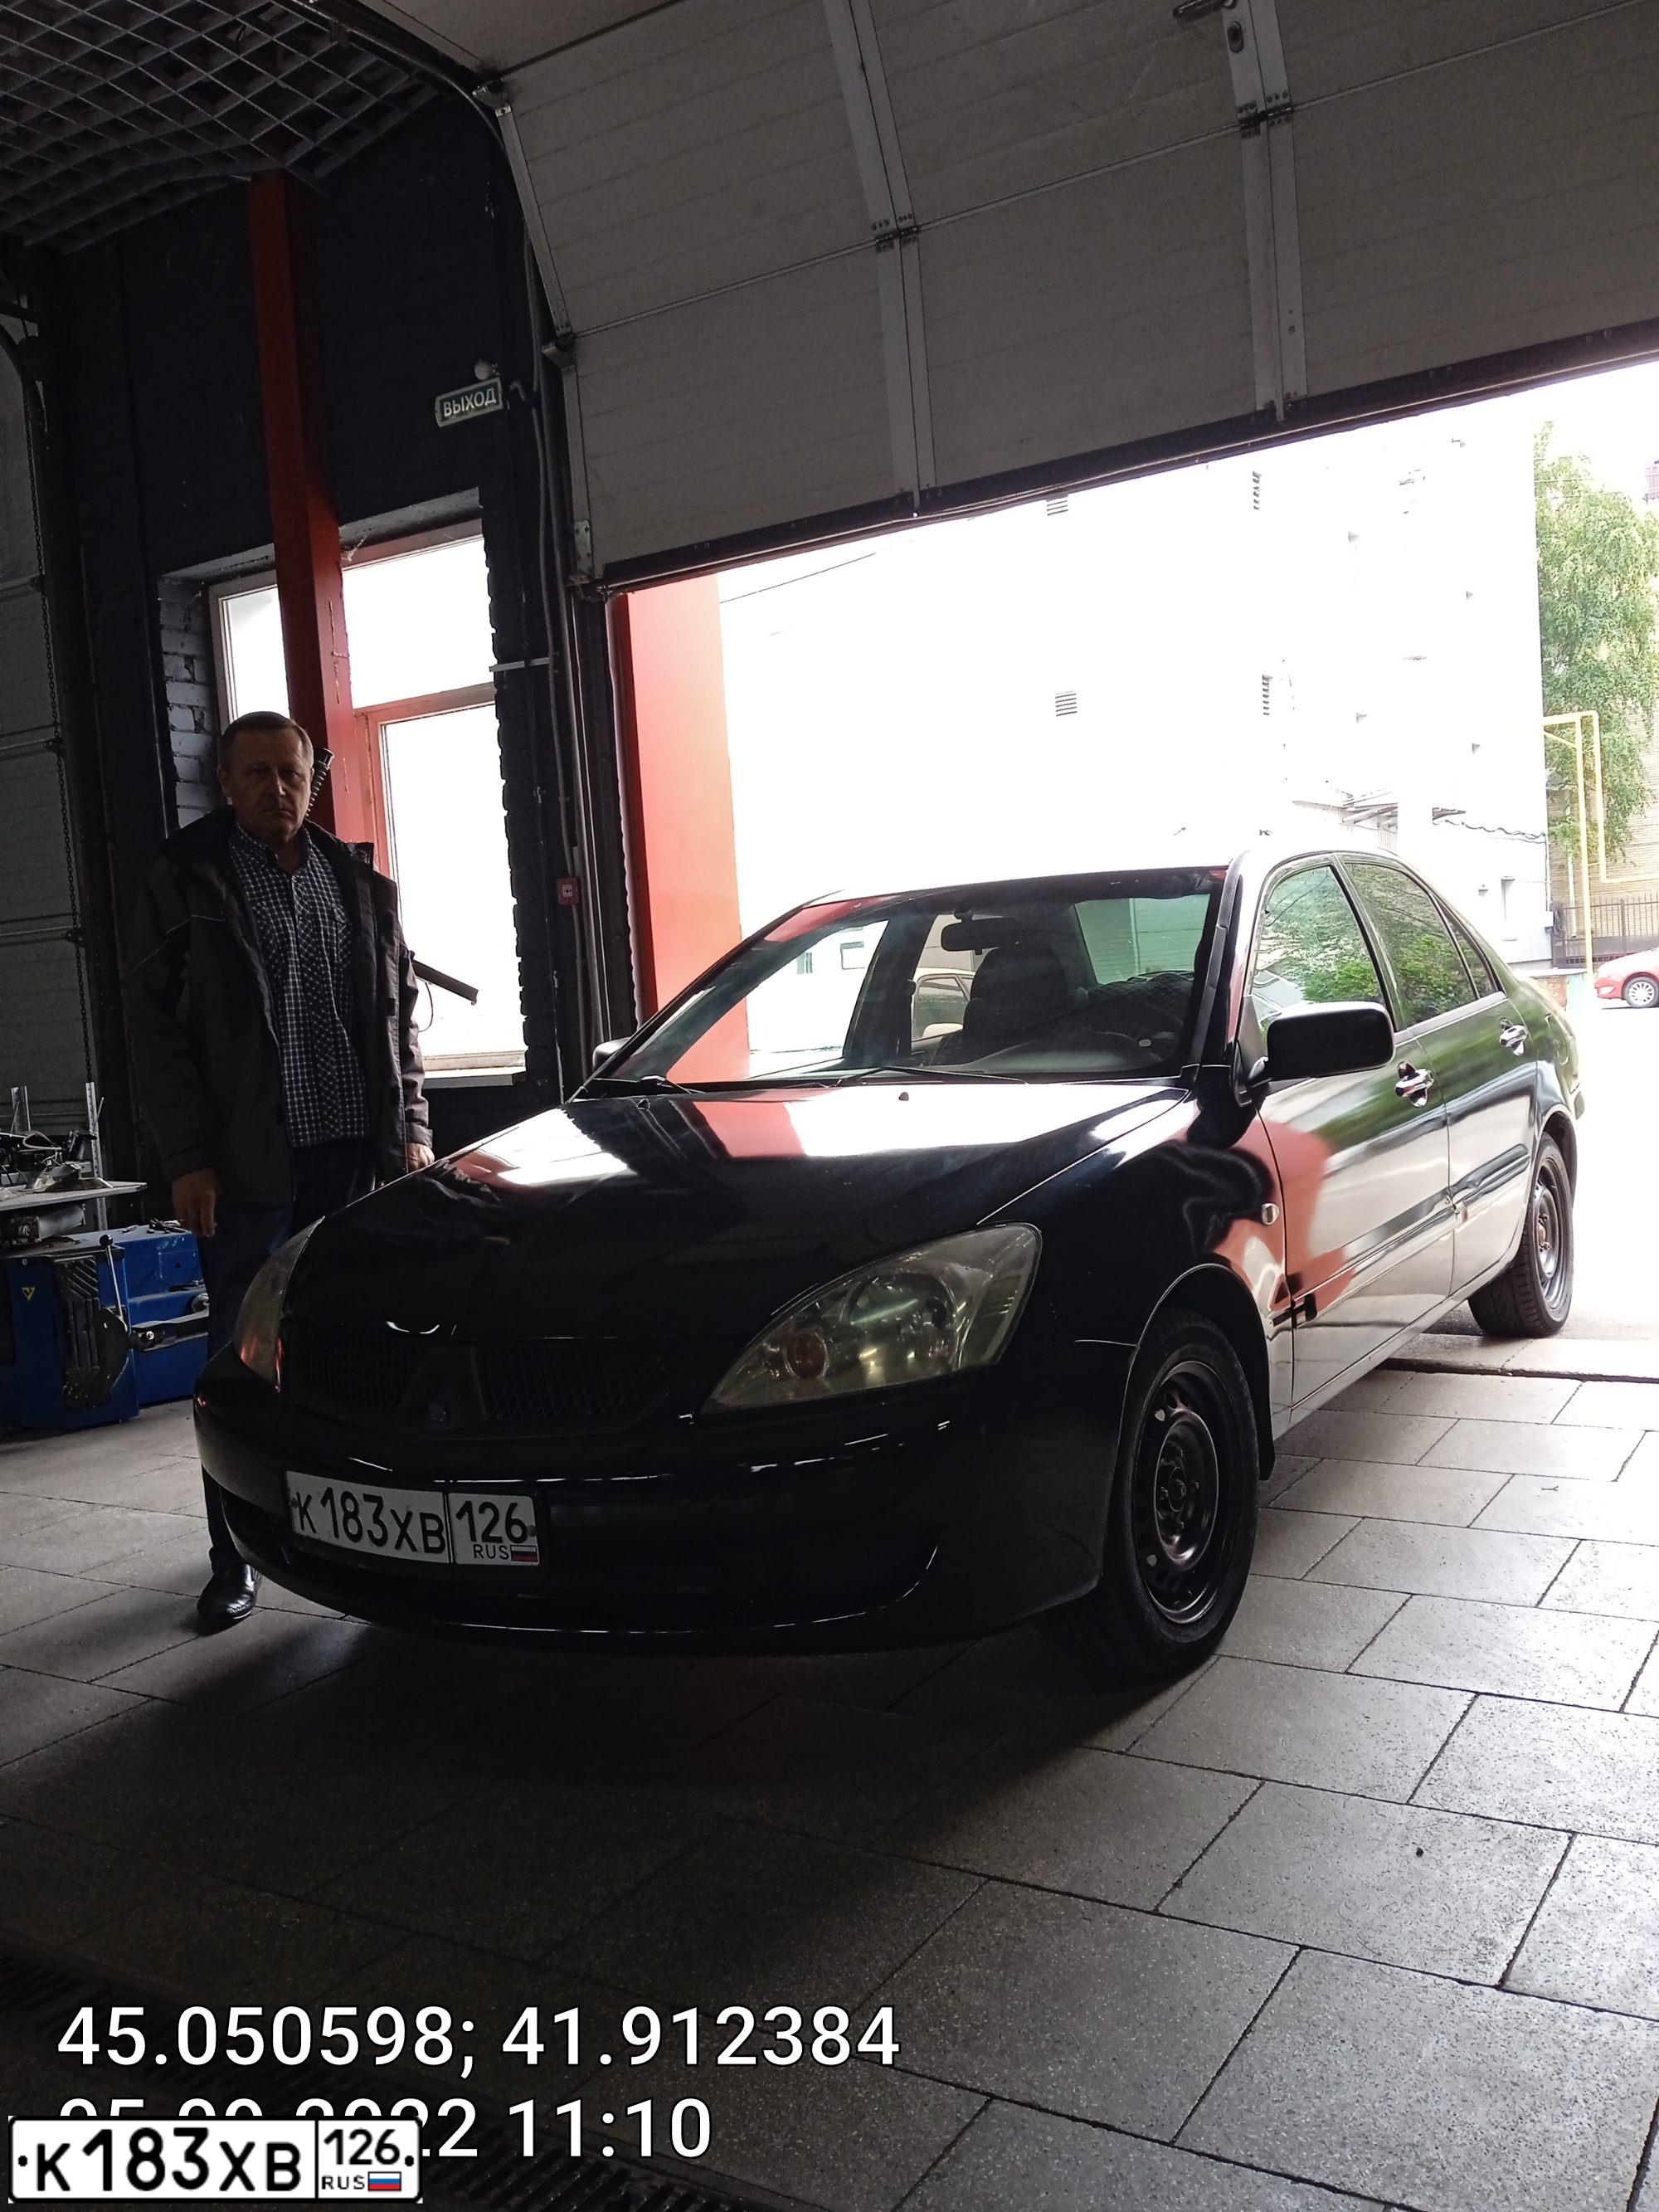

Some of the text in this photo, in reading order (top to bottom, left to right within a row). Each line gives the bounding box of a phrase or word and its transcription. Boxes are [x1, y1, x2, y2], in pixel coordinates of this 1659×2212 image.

[443, 387, 497, 417] ВЫХОД
[455, 1500, 528, 1544] 126
[473, 1544, 508, 1560] RUS
